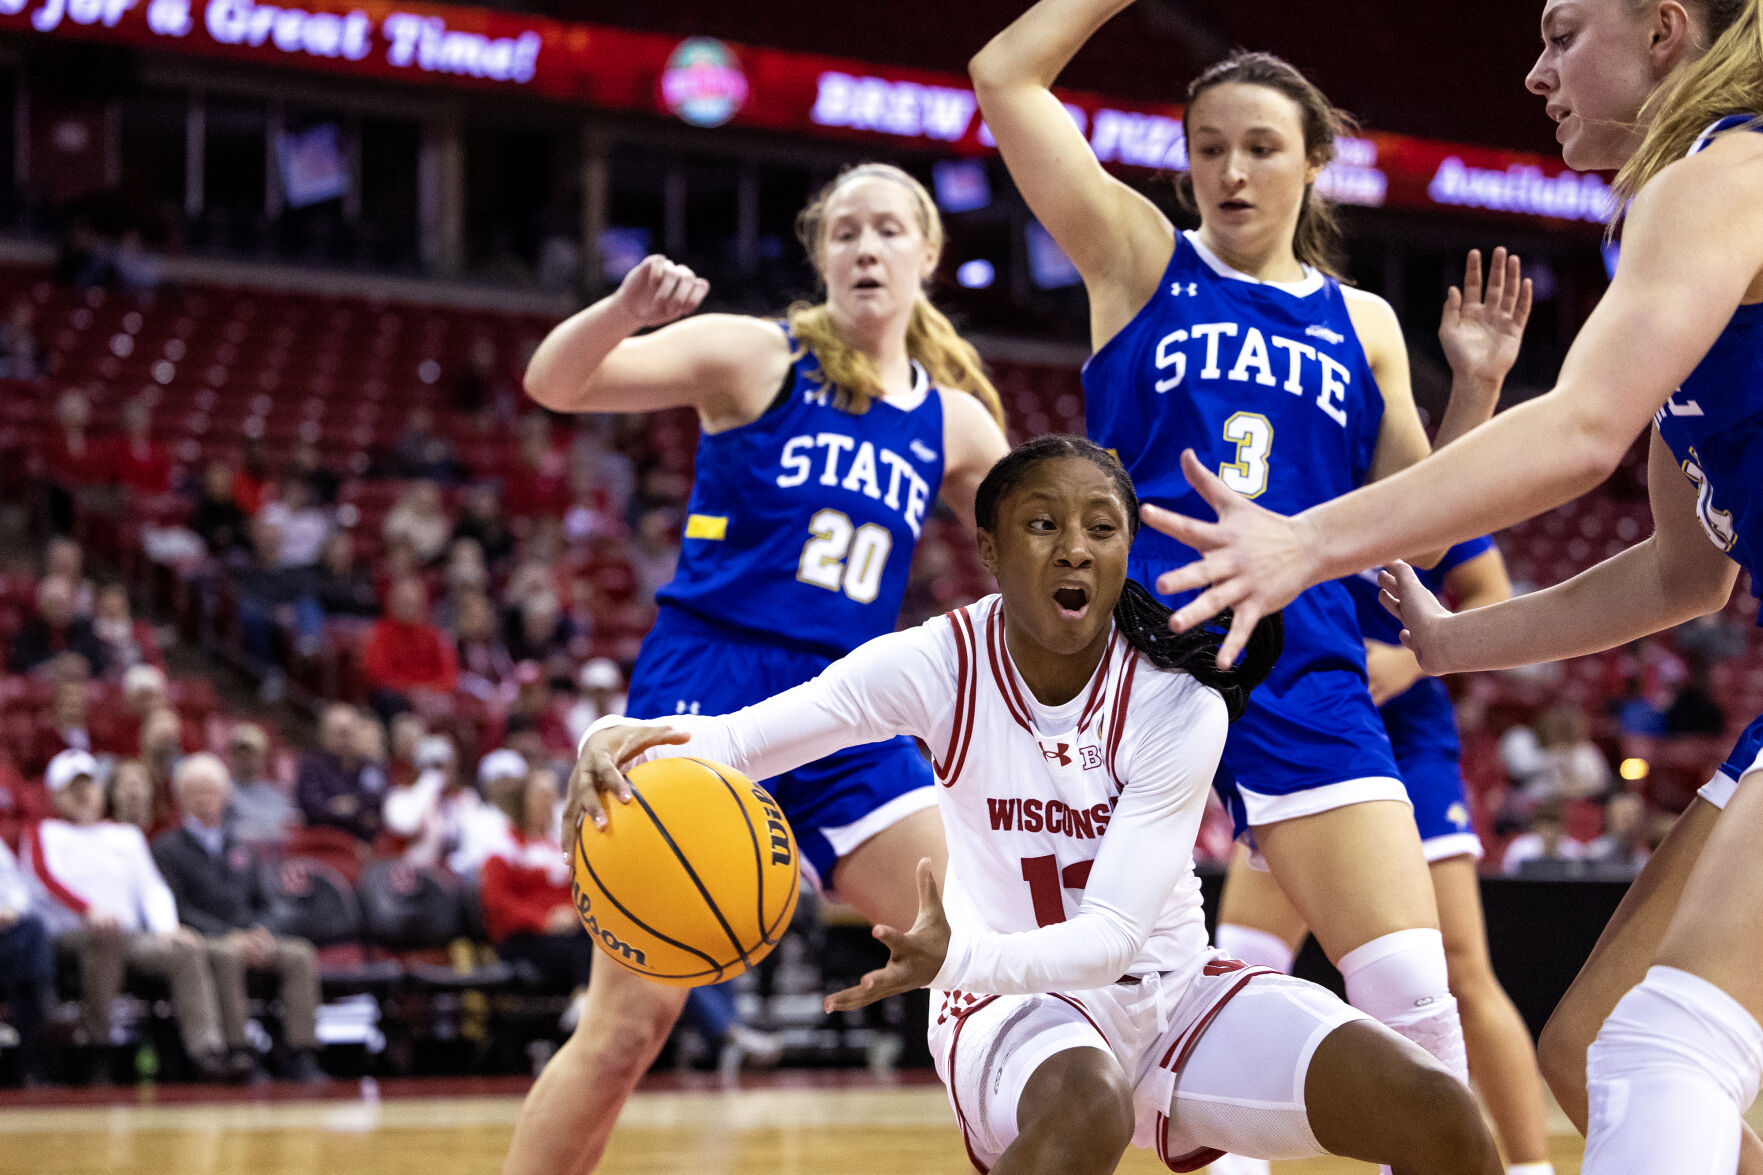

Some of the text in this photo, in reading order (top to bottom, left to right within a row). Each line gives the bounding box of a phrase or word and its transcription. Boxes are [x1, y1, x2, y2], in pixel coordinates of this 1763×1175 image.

[204, 0, 372, 61] Great
[383, 12, 541, 83] Time!
[811, 71, 978, 142] BREW
[1155, 322, 1350, 428] STATE
[776, 432, 930, 540] STATE
[1218, 411, 1274, 499] 3
[796, 507, 893, 605] 20
[752, 782, 792, 867] Wil
[986, 796, 1119, 840] WISCONS
[573, 881, 647, 967] lson
